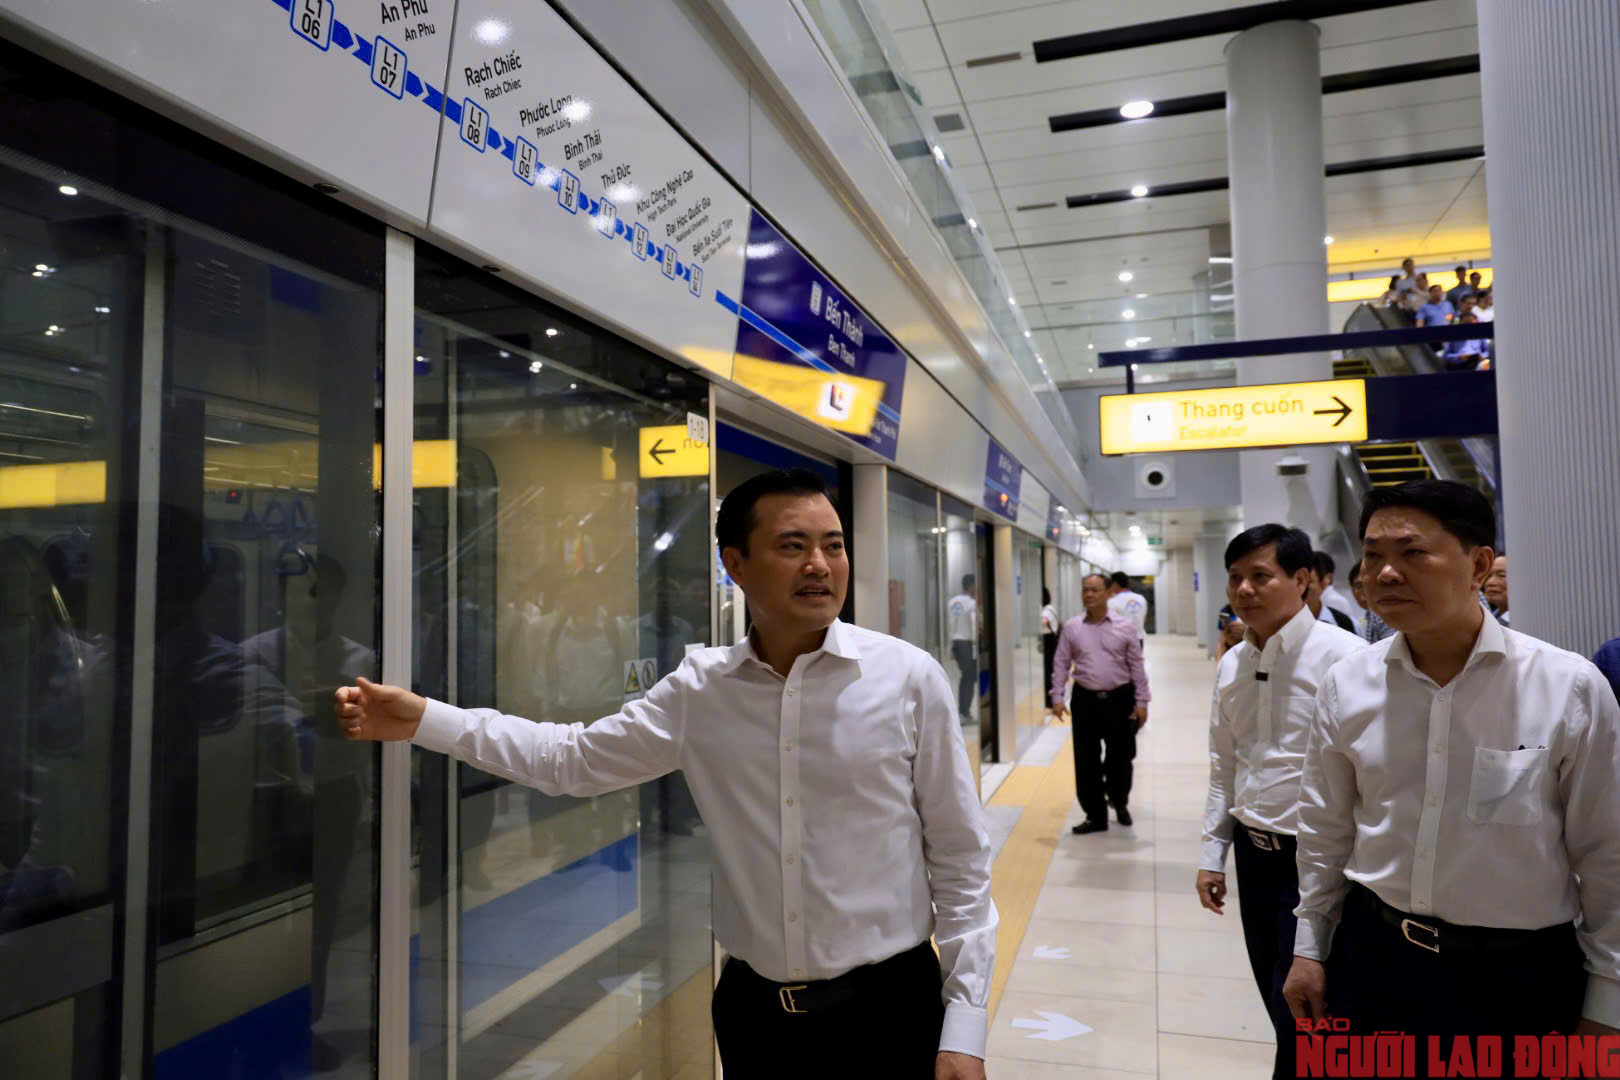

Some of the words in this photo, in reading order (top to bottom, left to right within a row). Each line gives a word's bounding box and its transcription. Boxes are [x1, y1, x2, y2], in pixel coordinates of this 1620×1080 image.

[305, 0, 322, 18] L1
[381, 2, 399, 24] An
[302, 13, 320, 39] 06
[405, 27, 417, 41] An
[418, 23, 435, 38] Phu
[383, 46, 398, 70] L1
[464, 62, 493, 87] Rạch
[493, 49, 522, 76] Chiếc
[380, 66, 396, 88] 07
[484, 84, 502, 100] Rach
[503, 79, 522, 94] Chiec
[470, 106, 482, 127] L1
[467, 124, 480, 144] 08
[521, 143, 532, 162] L1
[518, 160, 530, 178] 09
[1181, 401, 1244, 420] Thang
